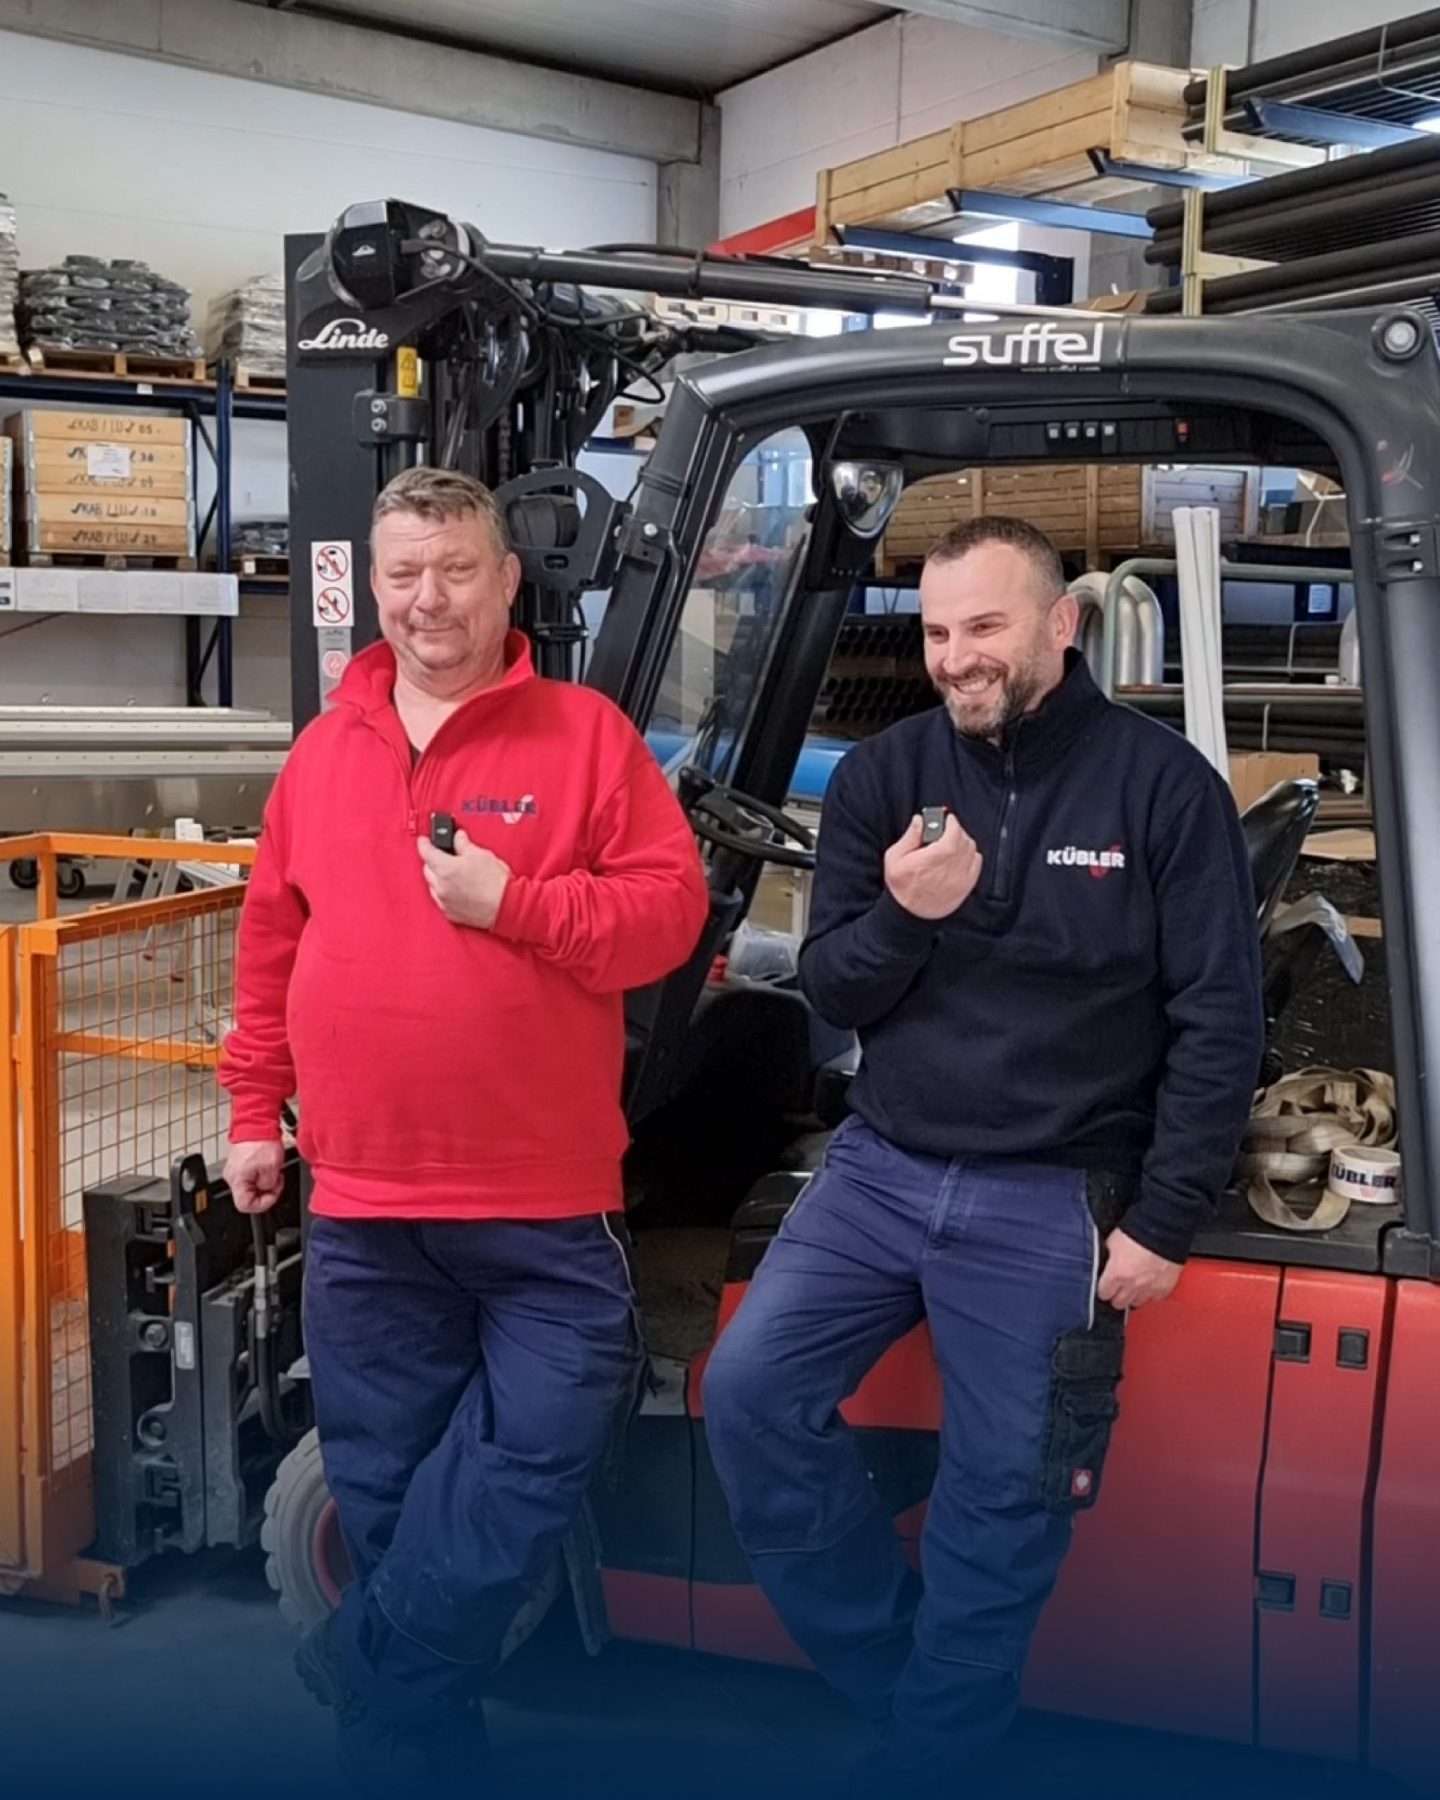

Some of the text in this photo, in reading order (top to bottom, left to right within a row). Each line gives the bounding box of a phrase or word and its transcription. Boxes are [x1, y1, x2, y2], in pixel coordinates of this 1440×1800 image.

[298, 318, 389, 350] Linde
[943, 323, 1104, 366] suffel
[1047, 845, 1126, 869] KÜBLER
